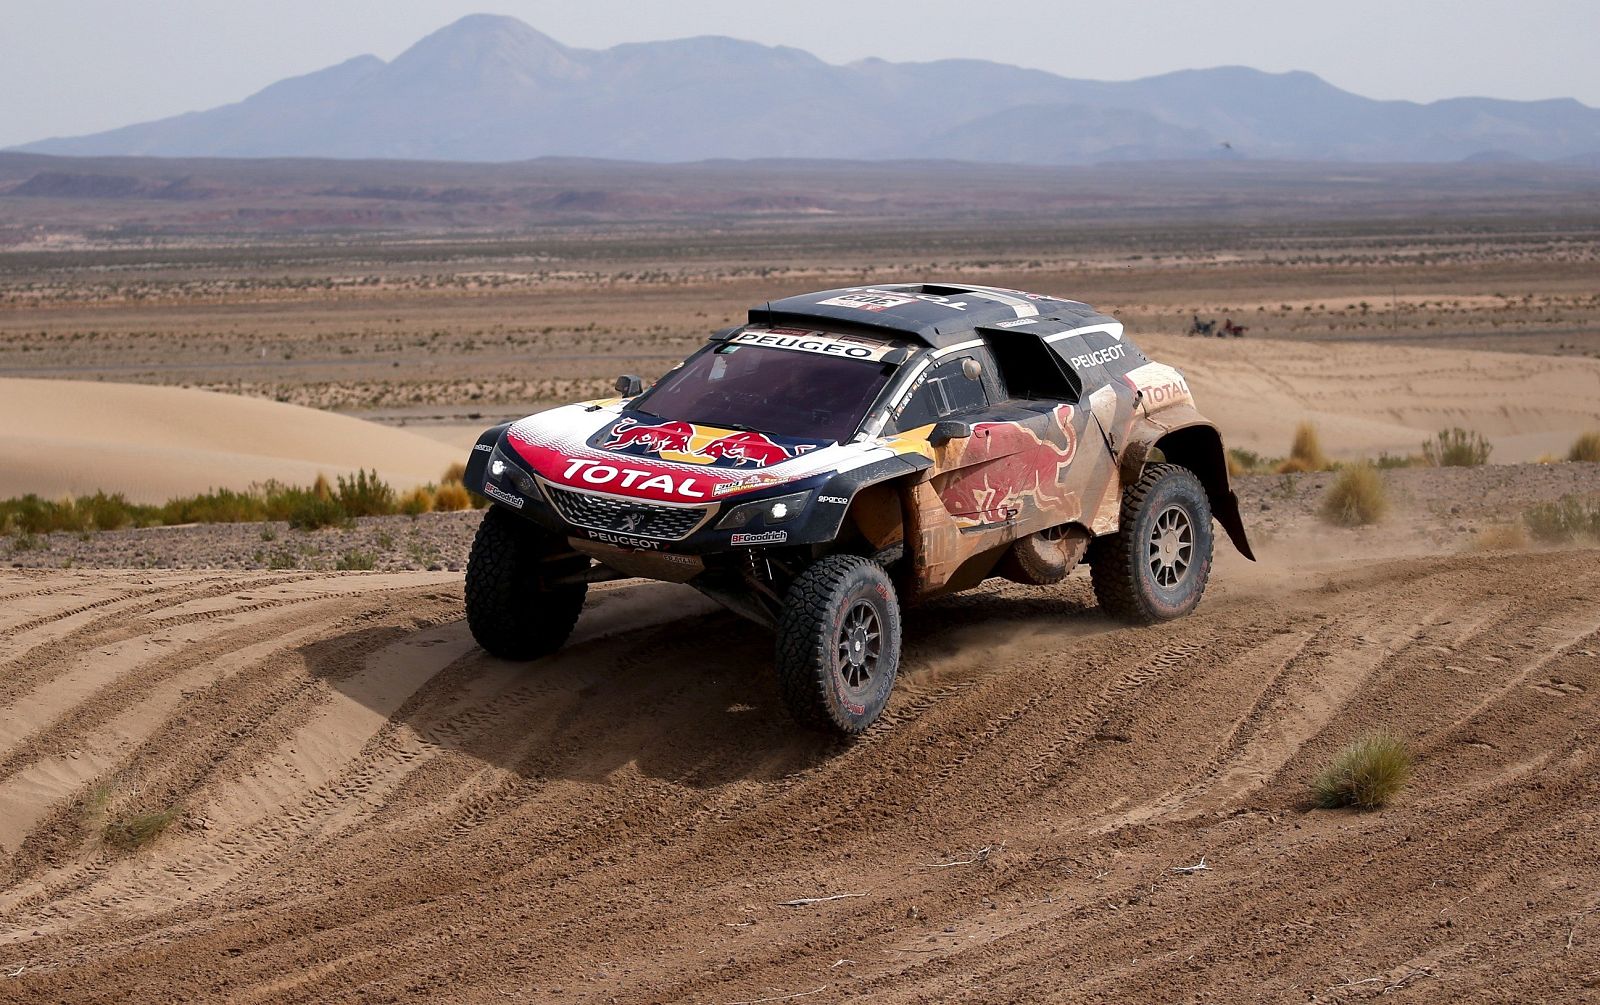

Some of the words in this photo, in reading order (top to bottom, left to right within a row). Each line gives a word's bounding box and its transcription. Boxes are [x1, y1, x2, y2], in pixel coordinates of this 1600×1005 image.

[1070, 343, 1126, 371] PEUGEOT
[1142, 380, 1188, 404] TOTAL
[563, 459, 705, 497] TOTAL
[818, 495, 848, 504] sparco
[588, 530, 660, 549] PEUGEOT
[732, 531, 787, 543] BFGoodrich
